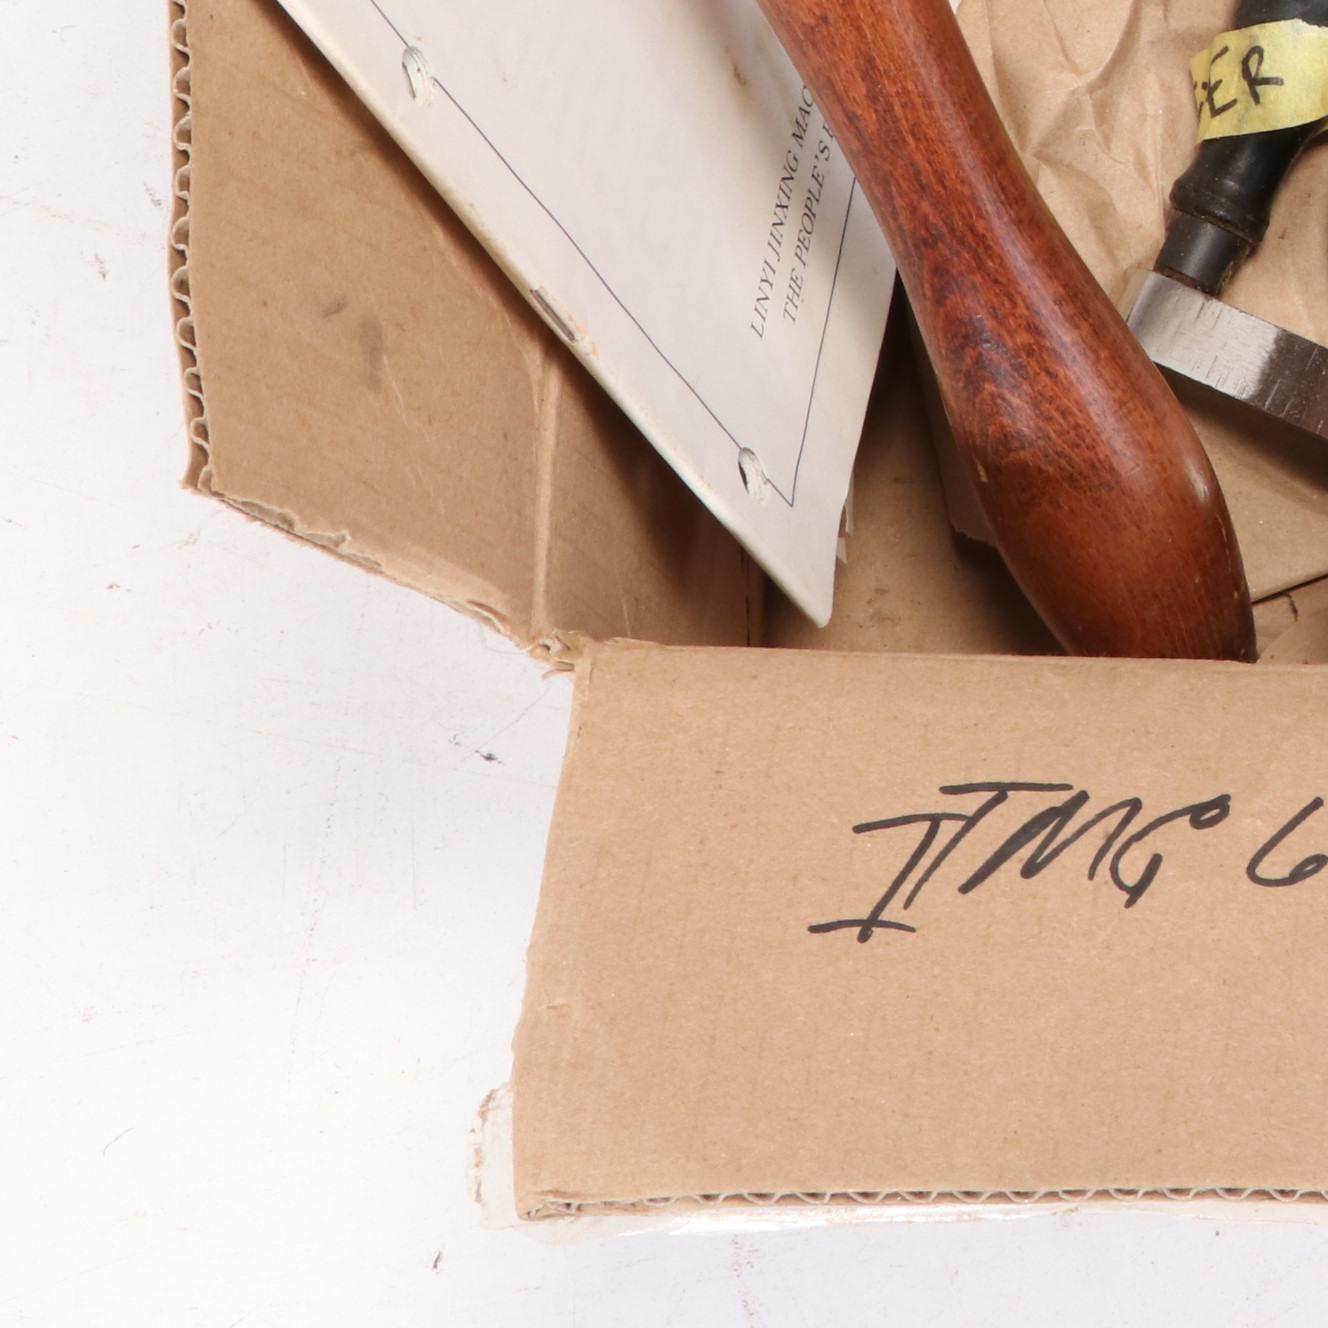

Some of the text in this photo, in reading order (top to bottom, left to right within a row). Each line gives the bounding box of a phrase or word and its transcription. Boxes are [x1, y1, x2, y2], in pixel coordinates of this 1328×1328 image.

[1193, 45, 1285, 119] ER
[750, 259, 777, 340] LINYI
[766, 149, 800, 263] JINXING
[793, 139, 831, 270] PEOPLE'S
[782, 267, 805, 326] THE
